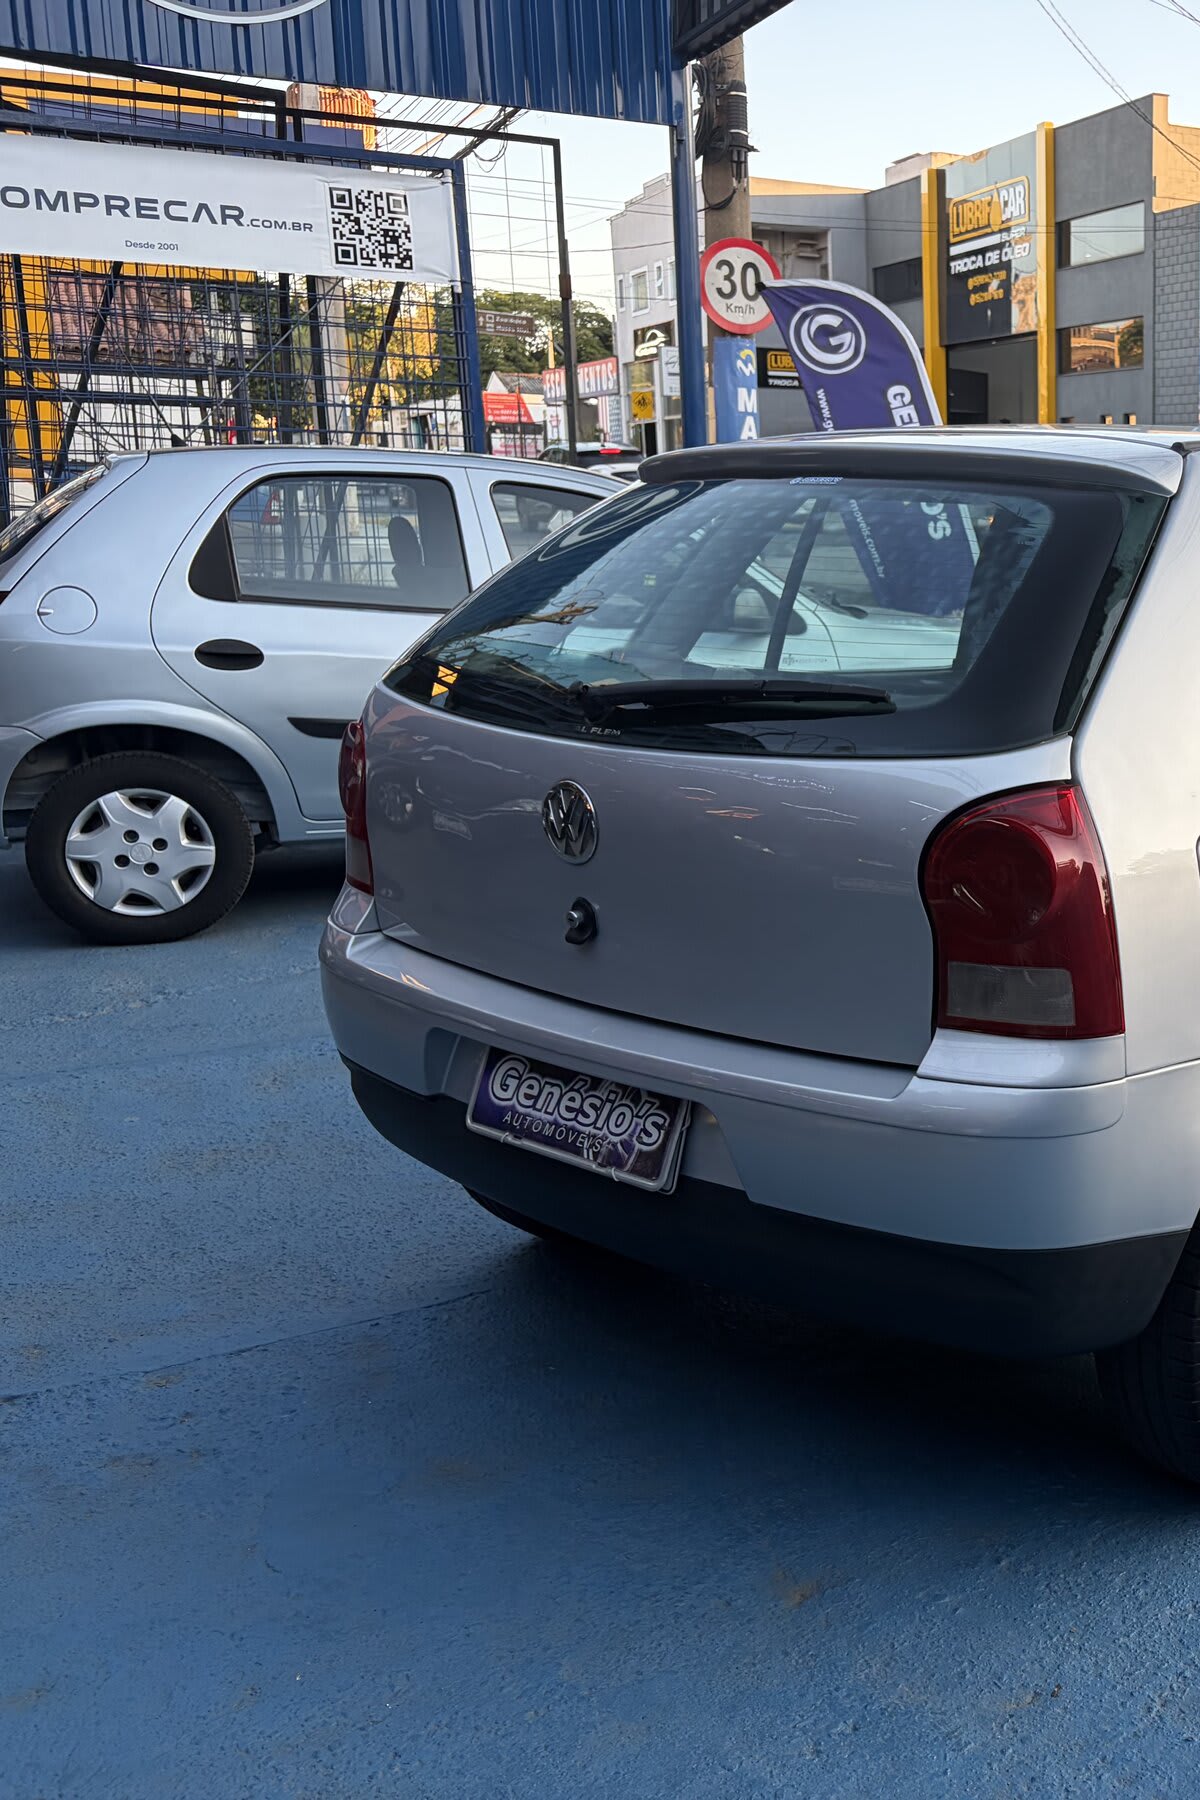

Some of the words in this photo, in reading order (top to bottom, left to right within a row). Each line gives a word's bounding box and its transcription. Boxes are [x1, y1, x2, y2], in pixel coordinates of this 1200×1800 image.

[125, 240, 155, 251] Desde
[157, 241, 179, 251] 2001
[950, 254, 984, 274] TROCA
[985, 250, 1000, 266] DE
[715, 259, 761, 302] 30
[725, 302, 755, 316] Km/h
[768, 378, 800, 387] TROCA
[887, 384, 921, 427] GE
[490, 1054, 670, 1150] Genésio's
[502, 1111, 602, 1152] AUTOMÓVEIS
